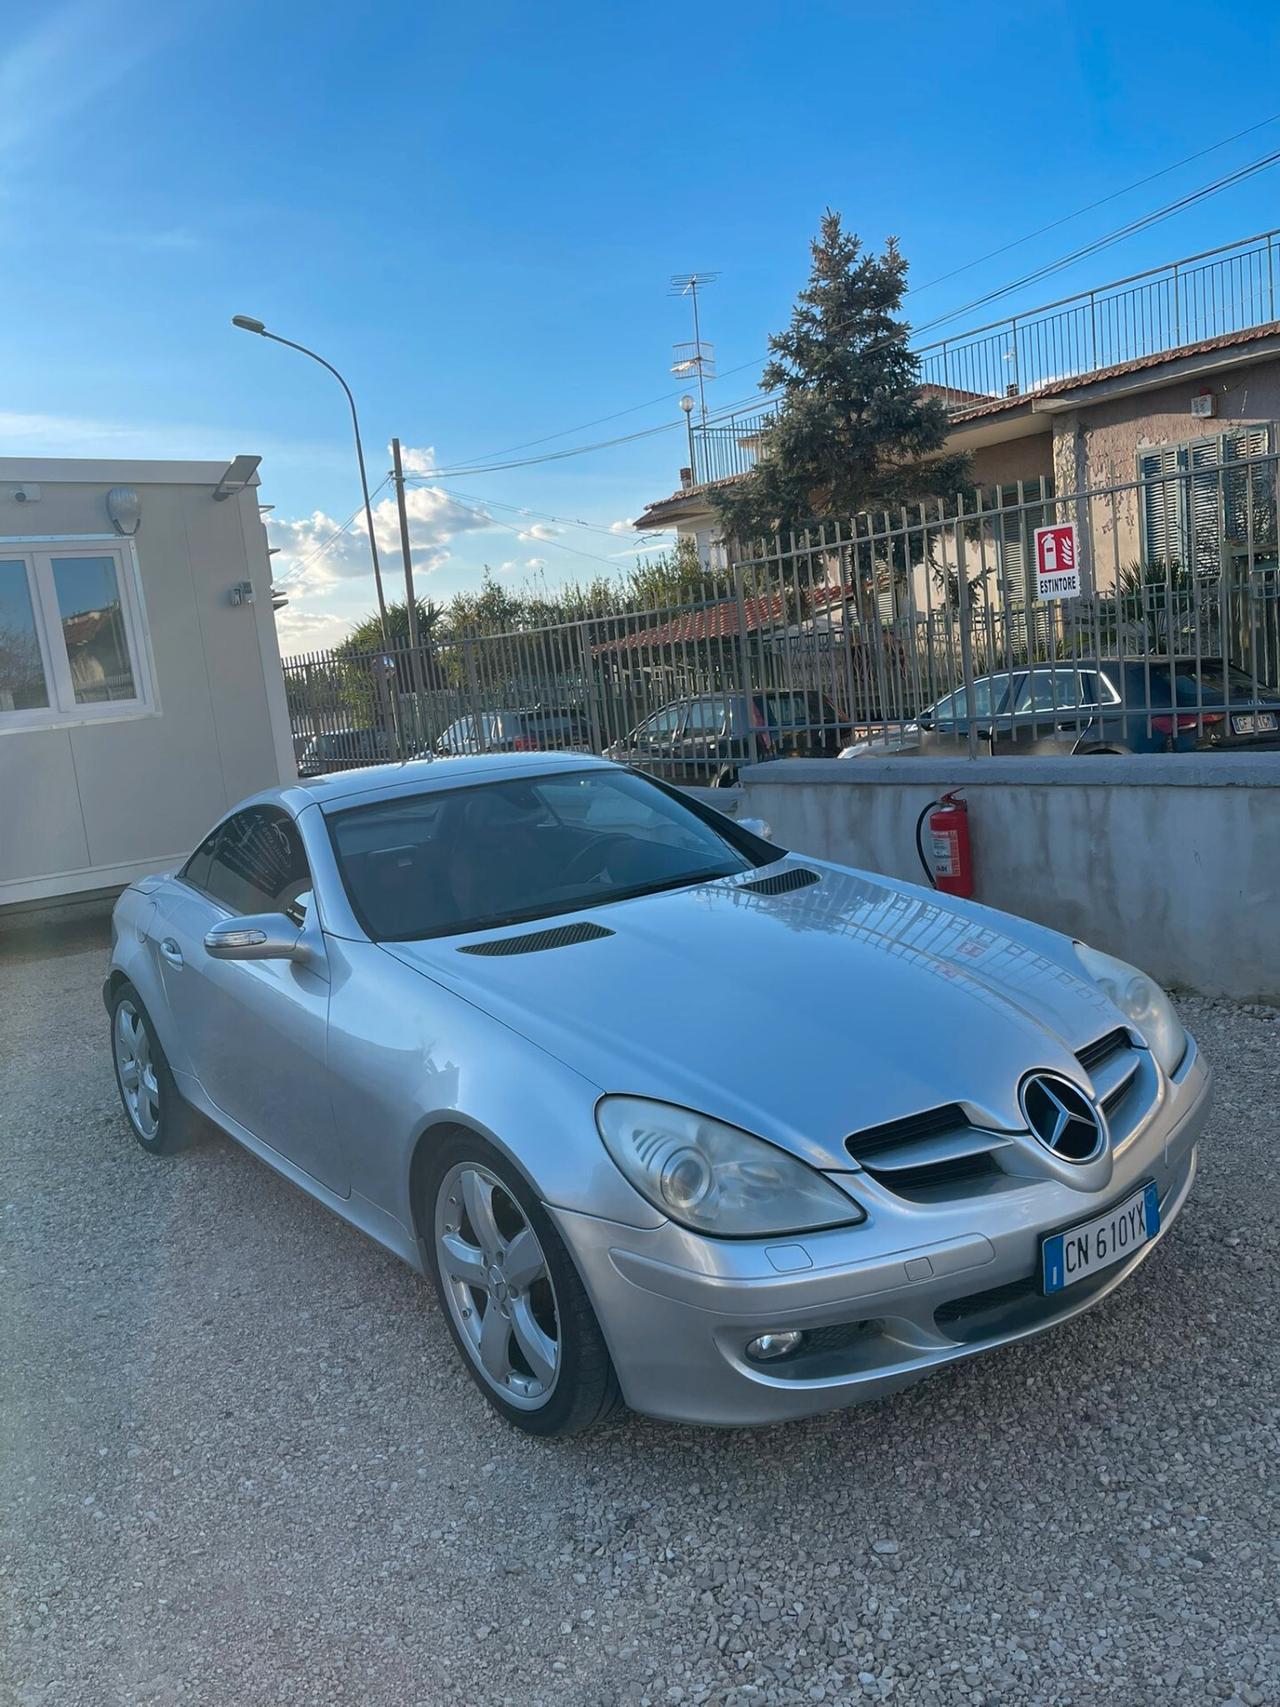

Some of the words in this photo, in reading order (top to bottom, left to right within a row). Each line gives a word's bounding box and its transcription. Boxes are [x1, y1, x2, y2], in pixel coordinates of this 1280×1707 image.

[1040, 576, 1076, 594] ESTINTORE
[1065, 1233, 1089, 1273] CN
[1096, 1200, 1146, 1259] 610YX
